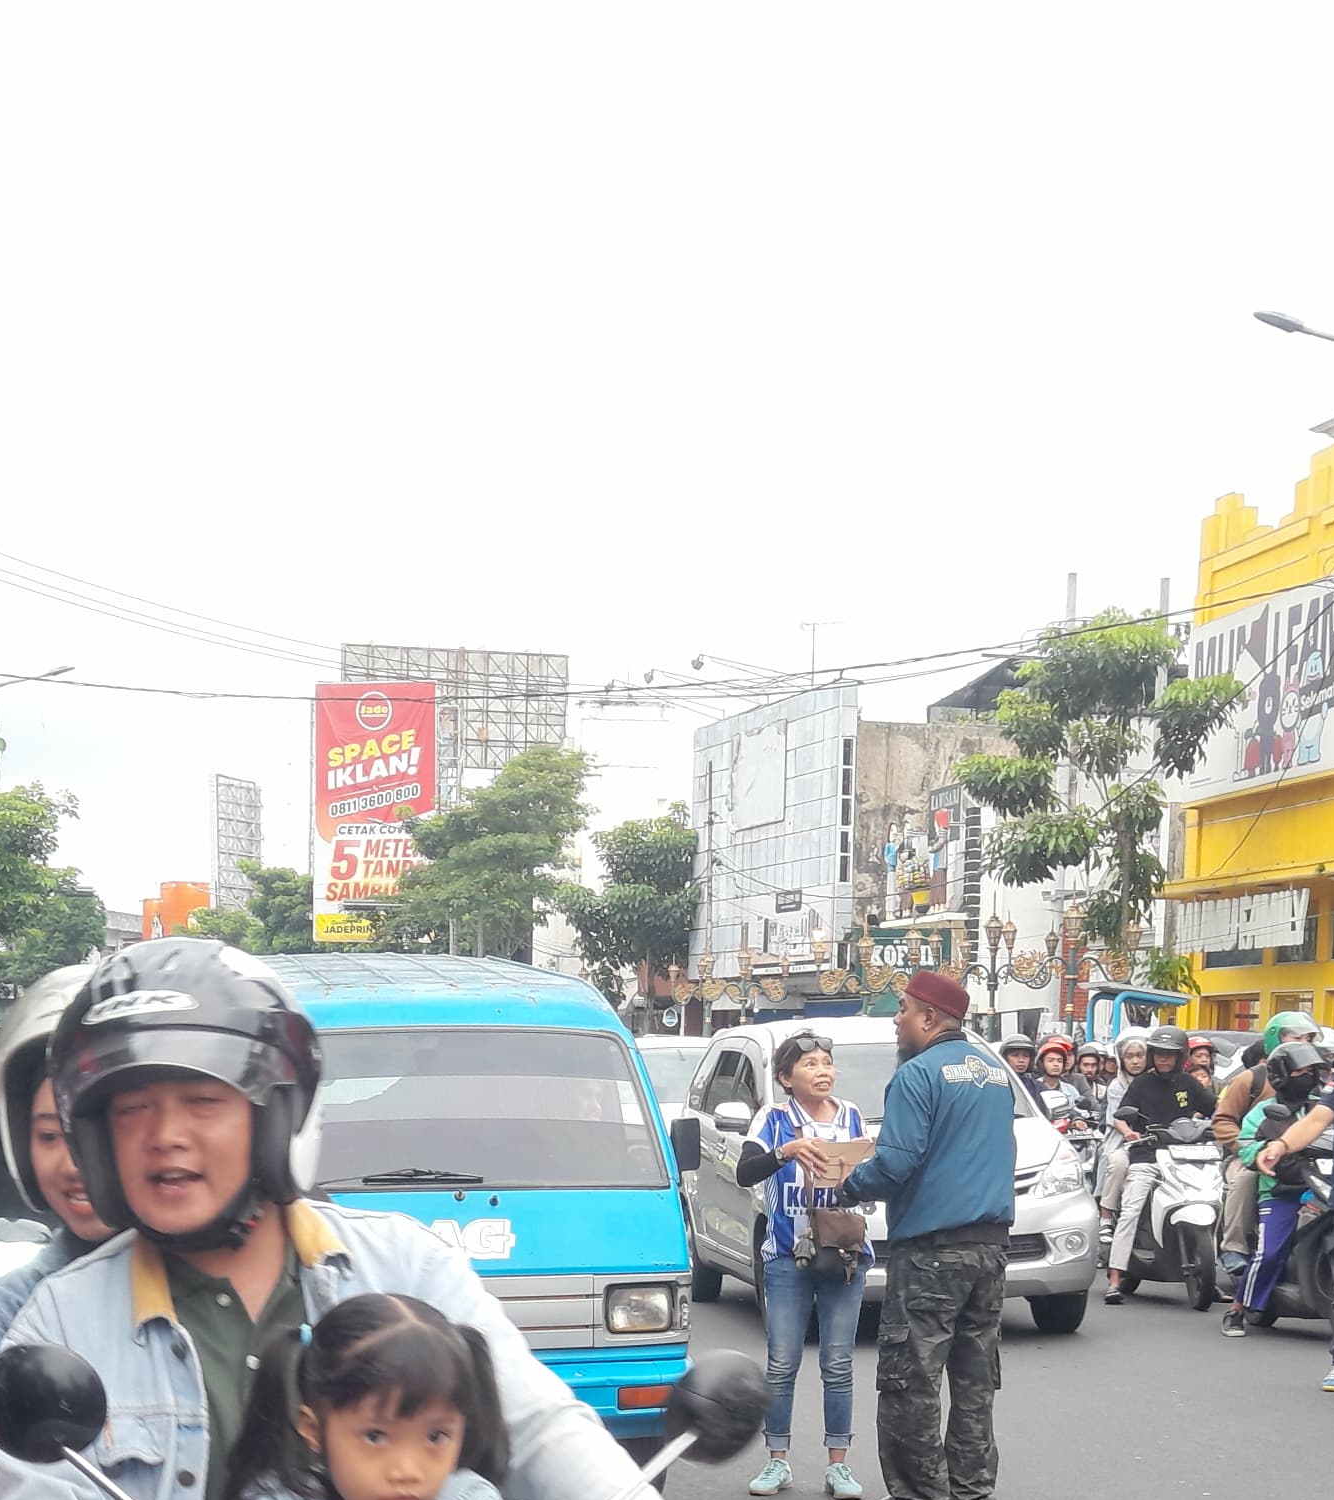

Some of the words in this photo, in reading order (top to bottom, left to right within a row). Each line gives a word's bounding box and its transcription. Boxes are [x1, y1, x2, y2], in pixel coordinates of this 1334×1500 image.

[328, 729, 415, 767] SPACE
[327, 747, 421, 790] IKLAN!
[331, 800, 357, 816] 0811
[361, 791, 392, 809] 3600
[396, 784, 419, 800] 800
[338, 825, 375, 835] CETAK
[330, 839, 361, 880] 5
[363, 839, 424, 859] METE
[324, 925, 374, 935] JADEPRIN
[787, 1186, 840, 1208] KORL
